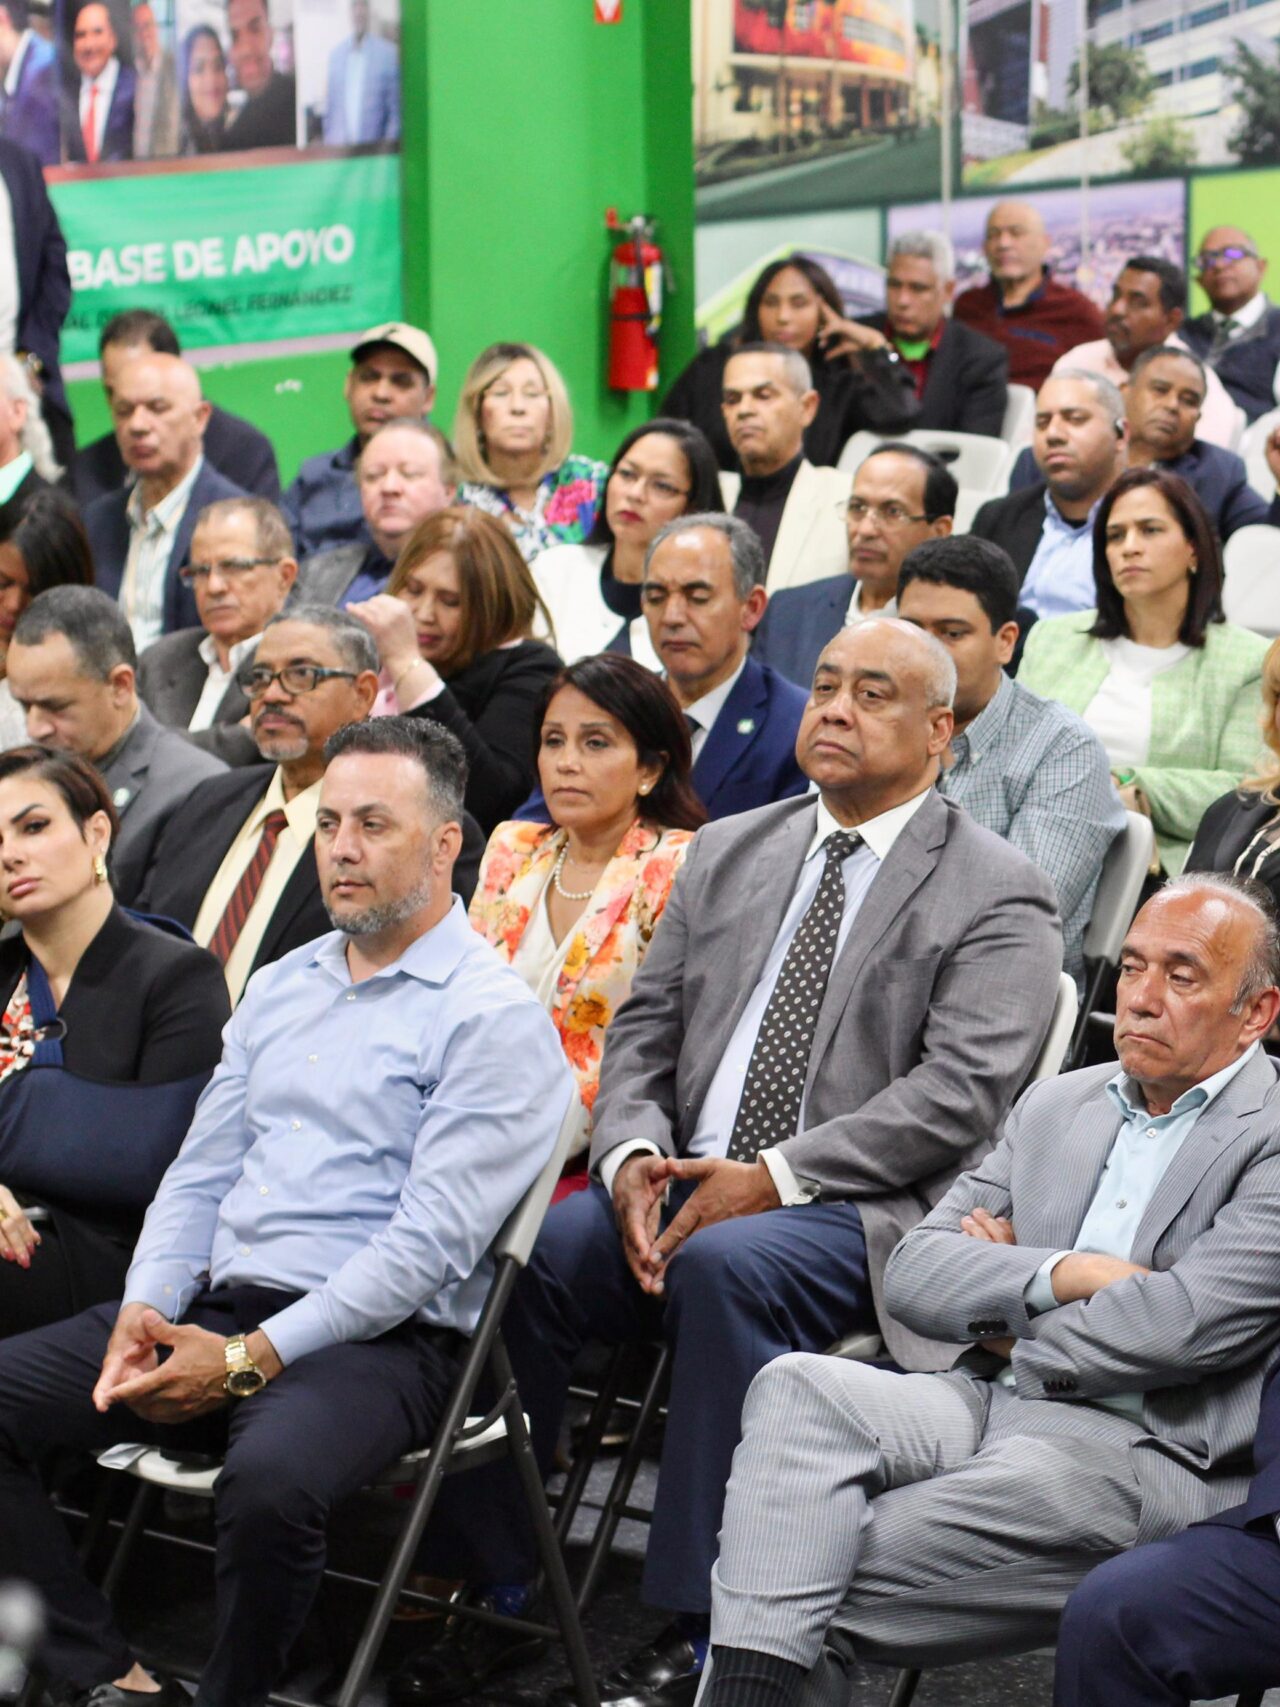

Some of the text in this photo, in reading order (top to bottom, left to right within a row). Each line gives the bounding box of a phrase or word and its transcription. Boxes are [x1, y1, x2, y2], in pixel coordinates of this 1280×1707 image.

[67, 224, 355, 290] BASE DE APOYO
